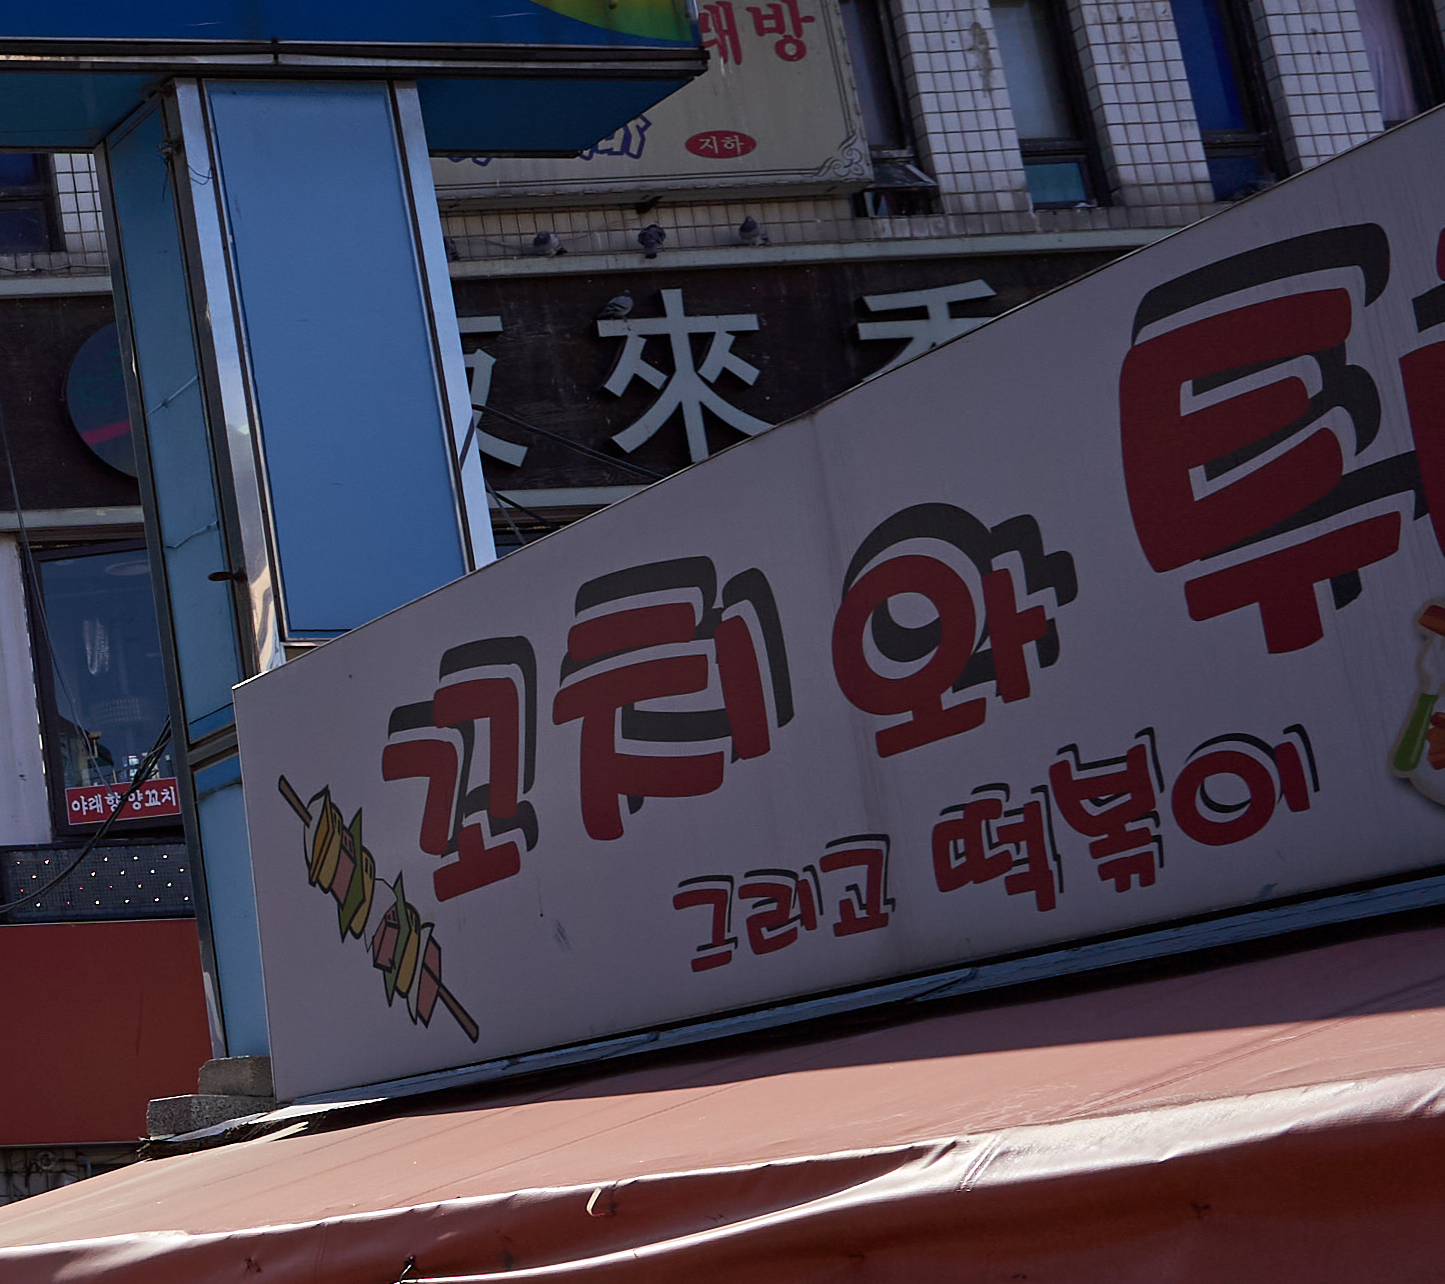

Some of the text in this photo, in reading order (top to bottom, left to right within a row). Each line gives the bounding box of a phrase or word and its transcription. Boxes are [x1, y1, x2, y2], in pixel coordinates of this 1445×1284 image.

[700, 130, 747, 157] 지하
[383, 502, 1076, 901] 꼬치와
[932, 723, 1322, 913] 떡볶이
[673, 833, 896, 974] 그리고
